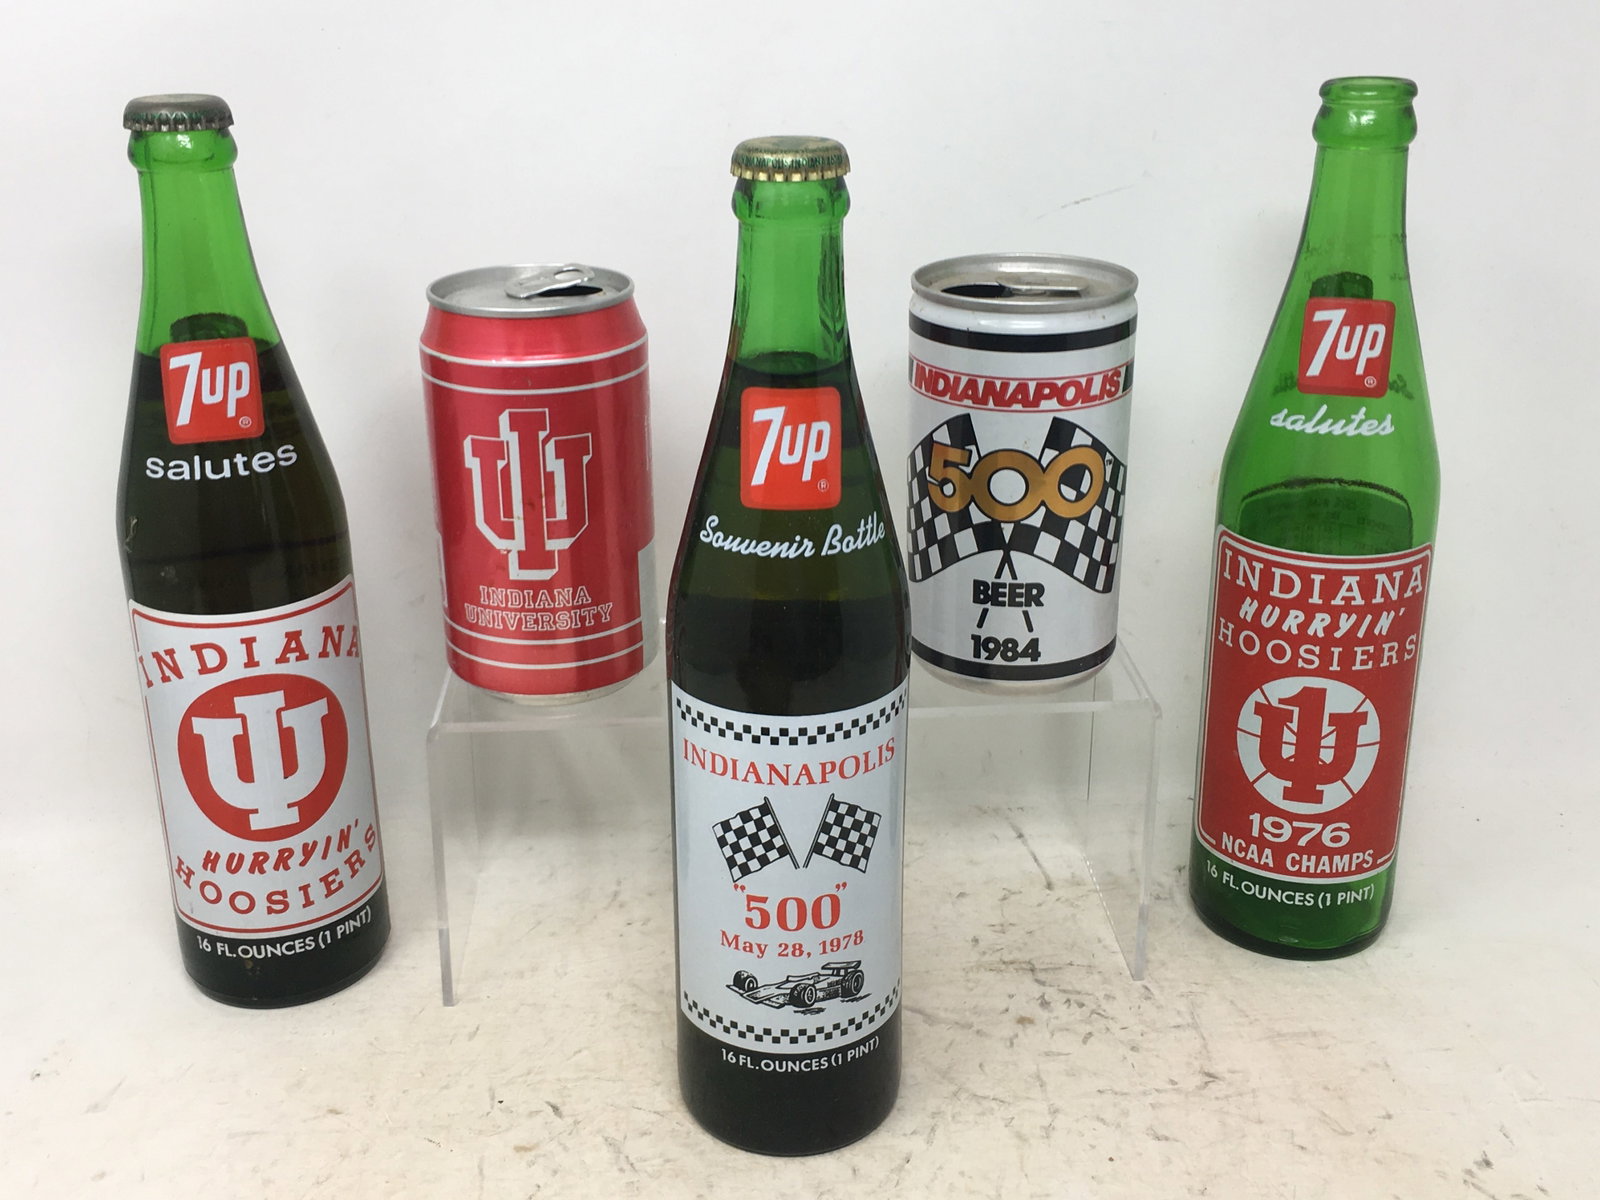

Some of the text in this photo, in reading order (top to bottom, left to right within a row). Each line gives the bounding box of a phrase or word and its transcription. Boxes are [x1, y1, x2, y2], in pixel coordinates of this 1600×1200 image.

[914, 361, 1121, 408] INDIANAPOLIS
[1270, 404, 1395, 436] salutes
[145, 444, 298, 480] salutes
[927, 442, 1106, 523] 500
[699, 511, 885, 559] Souvenir Bottle
[480, 585, 591, 608] INDIANA
[972, 579, 1045, 608] BEER
[1221, 548, 1423, 605] INDIANA
[464, 602, 613, 631] UNIVERSITY
[1239, 595, 1406, 638] HURRYIN'
[138, 624, 360, 689] INDIANA
[970, 633, 1042, 662] 1984
[1218, 616, 1417, 672] HOOSIERS
[682, 737, 895, 787] INDIANAPOLIS
[202, 818, 359, 875] HURRYIN'
[1221, 831, 1373, 874] NCAA CHAMPS
[1249, 812, 1351, 848] 1976
[174, 823, 377, 916] HOOSIERS
[1206, 860, 1218, 878] 16
[1318, 892, 1331, 909] (1
[1337, 883, 1375, 905] PINT)
[197, 935, 211, 952] 16
[318, 930, 331, 949] (1
[336, 905, 371, 939] PINT)
[720, 929, 864, 959] May 28, 1978
[721, 1048, 737, 1064] 16
[831, 1052, 842, 1067] (1
[847, 1035, 879, 1062] PINT)
